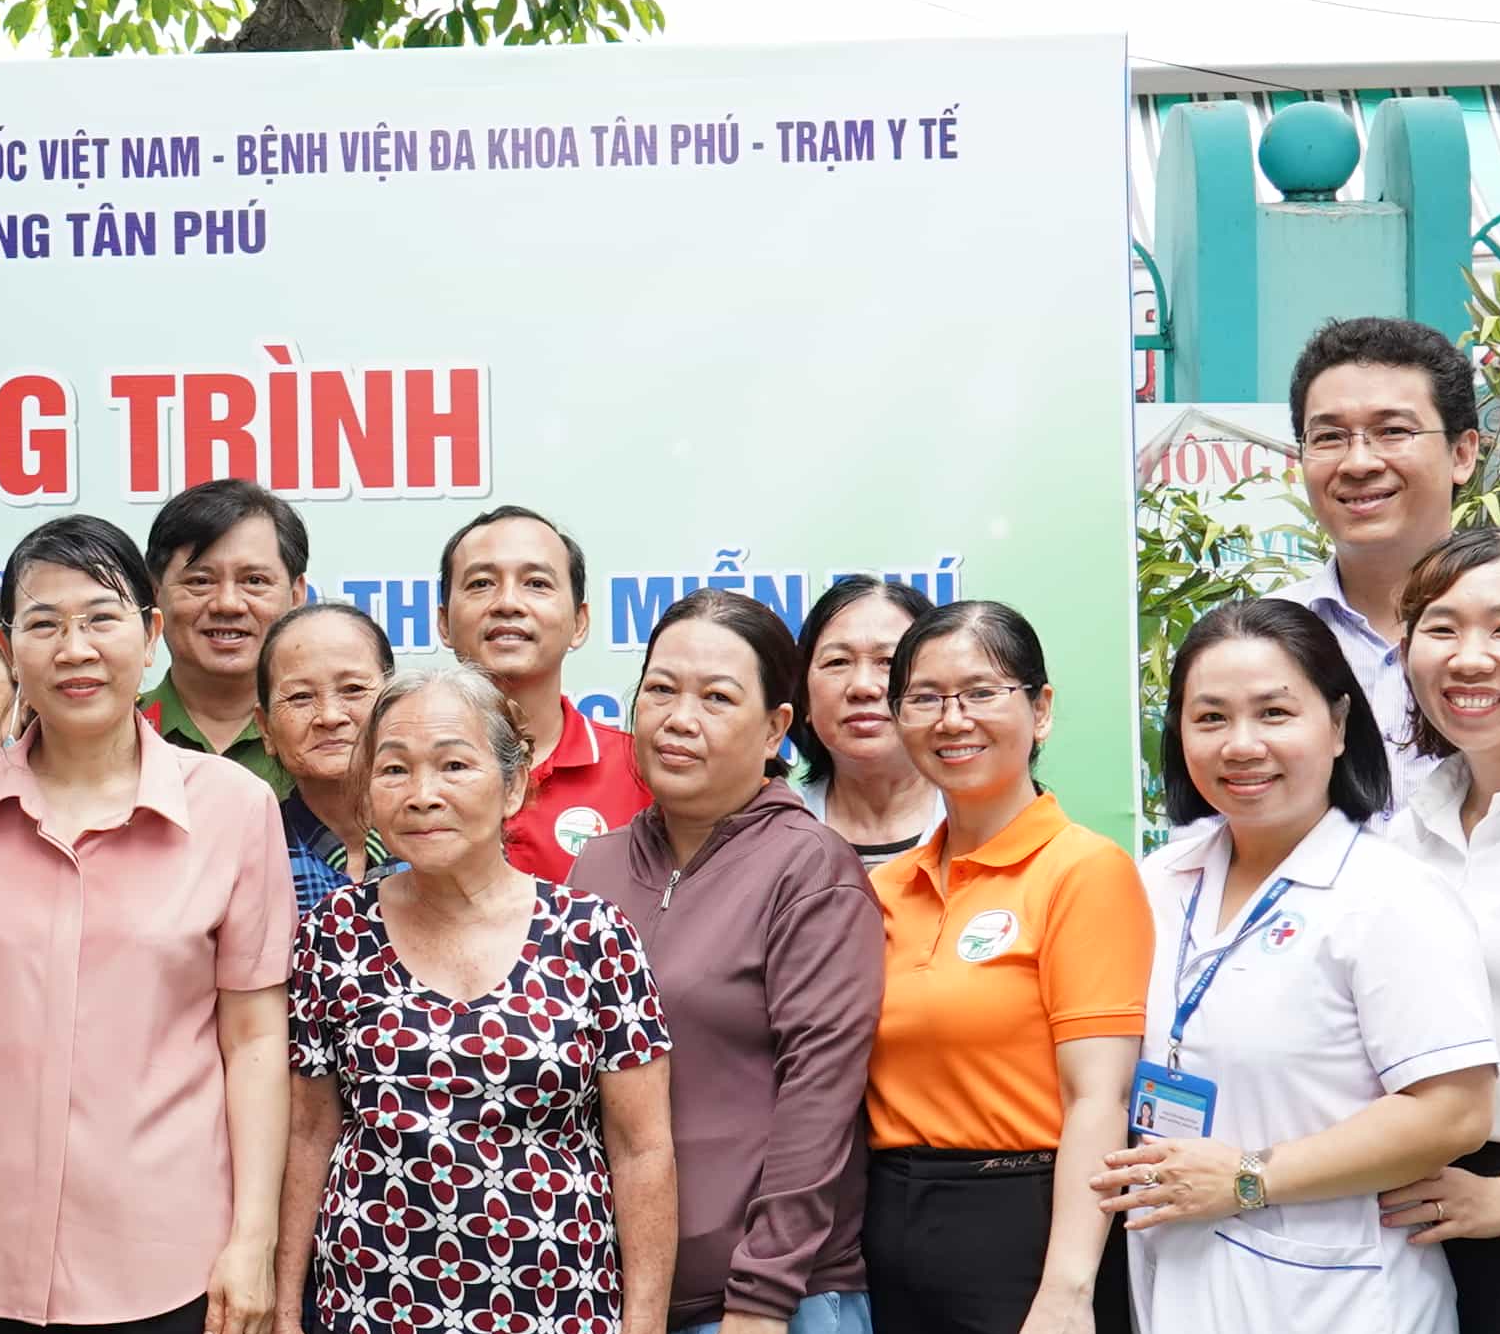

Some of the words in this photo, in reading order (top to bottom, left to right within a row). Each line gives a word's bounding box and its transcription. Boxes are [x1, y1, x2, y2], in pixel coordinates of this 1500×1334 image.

[39, 129, 110, 189] VIỆT
[121, 136, 200, 179] NAM
[237, 125, 328, 184] BỆNH
[340, 121, 418, 182] VIỆN
[429, 129, 476, 172] ĐA
[487, 126, 580, 170] KHOA
[590, 116, 658, 168] TÂN
[670, 113, 740, 166] PHÚ
[776, 118, 875, 172] TRẠM
[887, 119, 908, 160] Y
[918, 103, 960, 160] TẾ
[65, 203, 157, 257] TÂN
[172, 199, 267, 255] PHÚ
[110, 344, 482, 493] TRÌNH
